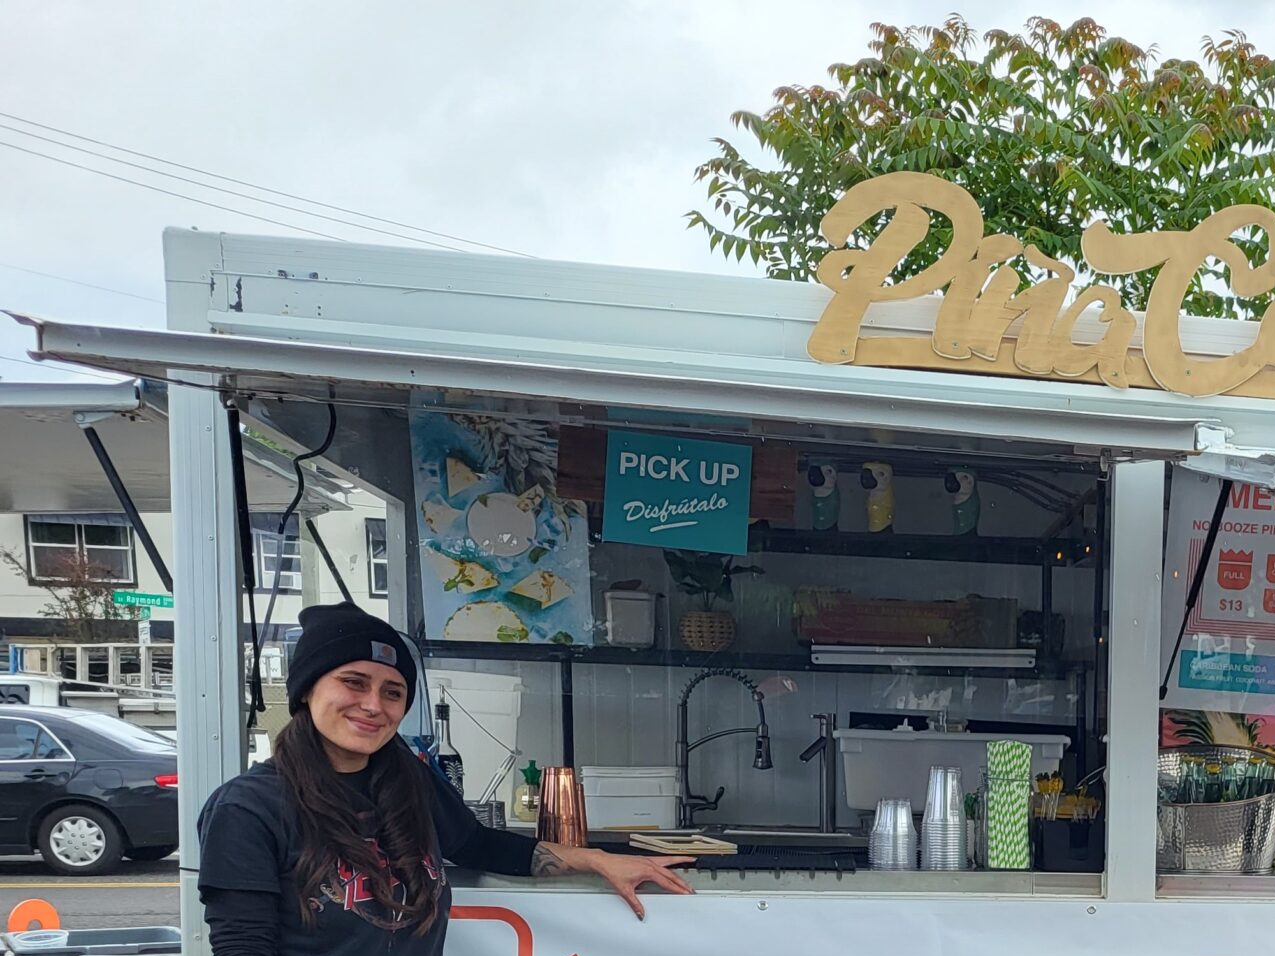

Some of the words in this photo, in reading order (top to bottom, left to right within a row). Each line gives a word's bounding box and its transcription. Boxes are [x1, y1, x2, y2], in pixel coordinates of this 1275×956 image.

[805, 170, 1137, 392] Piña
[619, 451, 690, 482] PICK
[700, 461, 740, 486] UP
[623, 493, 728, 522] Disfrútalo
[1223, 571, 1245, 580] FULL
[126, 596, 161, 605] Raymond
[1219, 598, 1243, 611] $13
[1242, 665, 1268, 673] SODA
